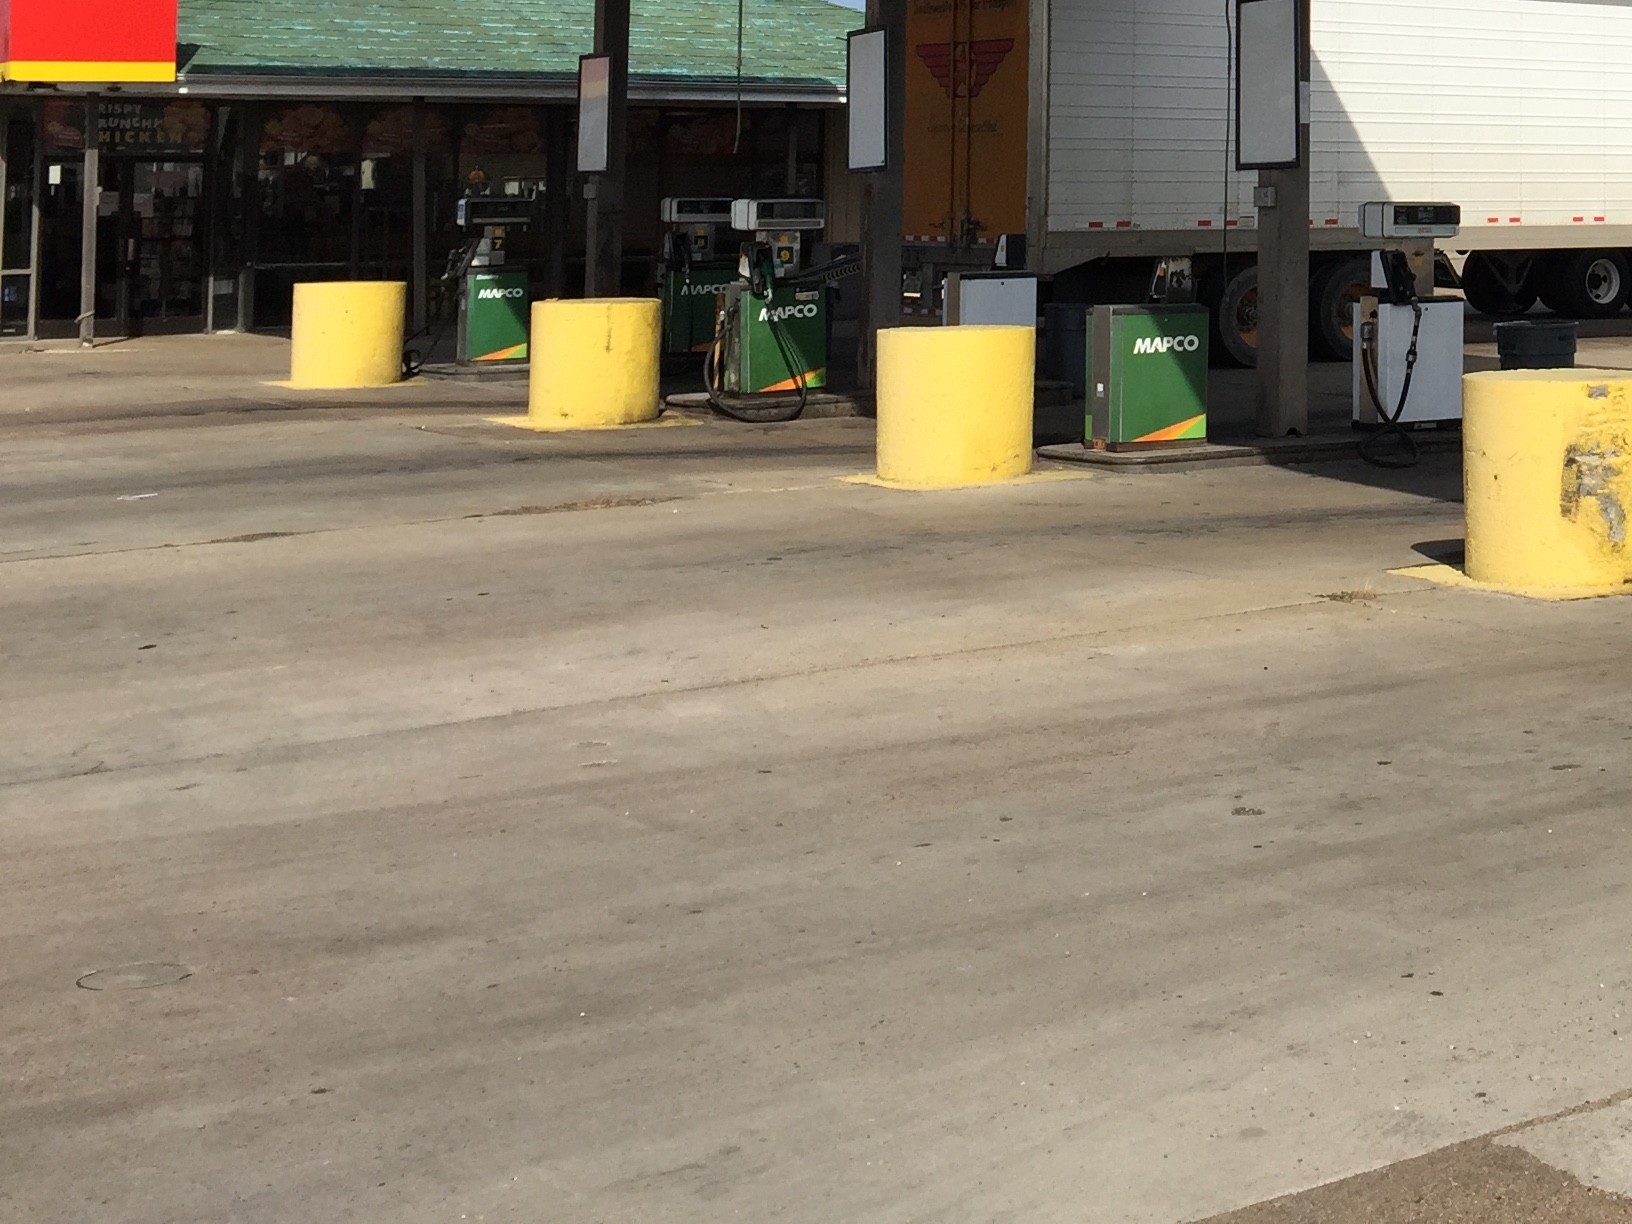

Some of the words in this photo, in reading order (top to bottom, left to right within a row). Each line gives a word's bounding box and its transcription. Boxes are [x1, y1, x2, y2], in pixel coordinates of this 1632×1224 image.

[98, 103, 142, 114] RISPY
[98, 117, 162, 129] RUNCHY
[98, 130, 183, 144] HICKEN
[494, 239, 502, 249] 7
[477, 287, 524, 299] MAPCO
[758, 303, 818, 322] MAPCO
[1133, 334, 1200, 355] MAPCO
